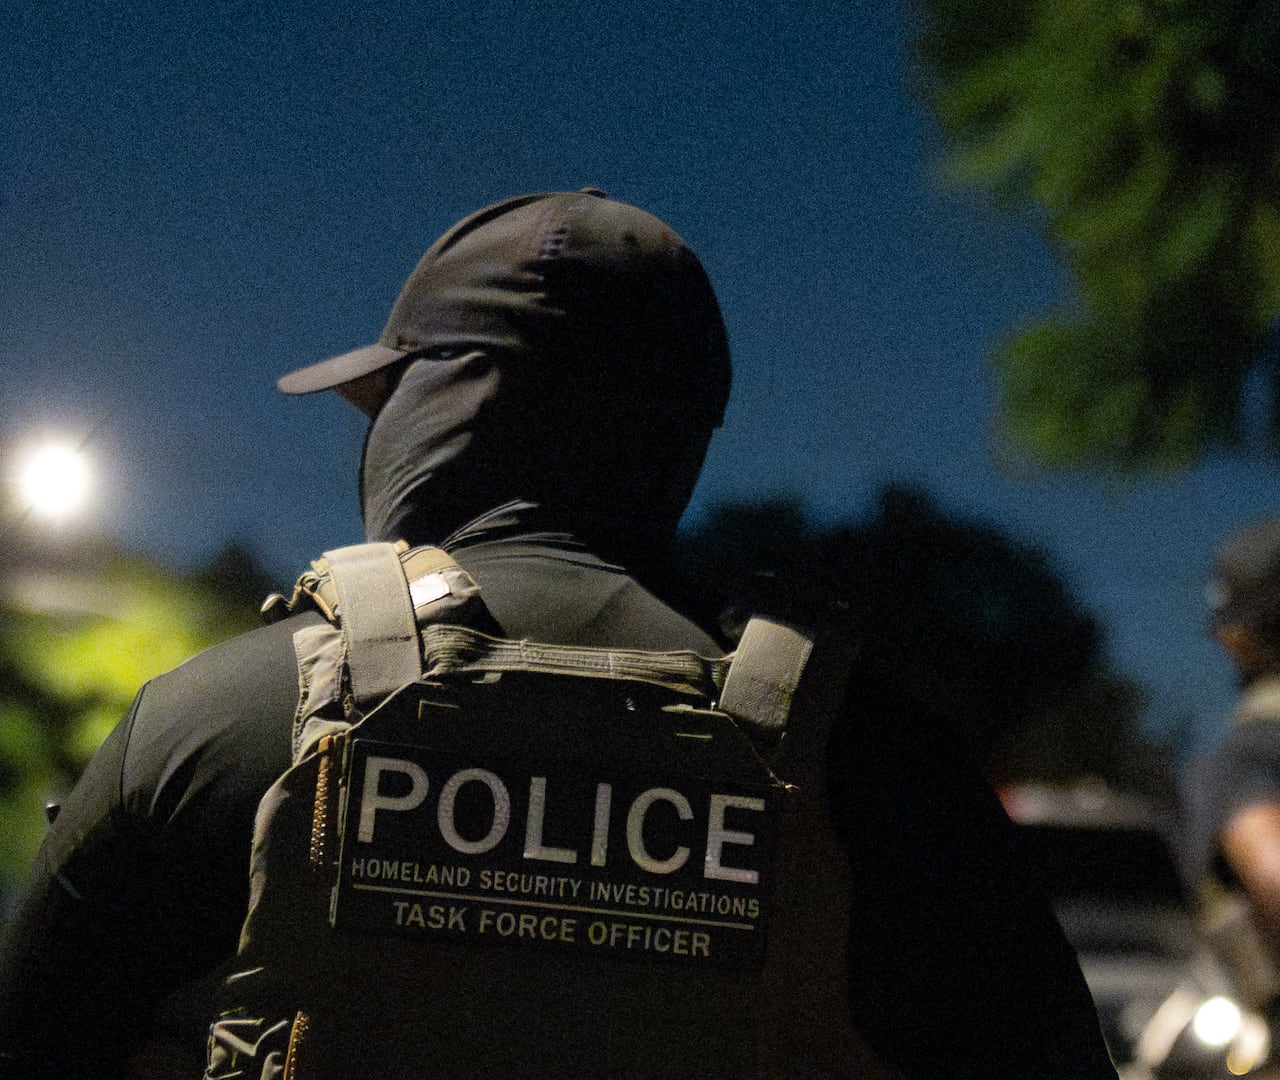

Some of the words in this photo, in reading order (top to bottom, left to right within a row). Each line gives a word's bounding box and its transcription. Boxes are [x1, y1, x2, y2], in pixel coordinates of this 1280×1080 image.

[357, 756, 765, 884] POLICE
[351, 857, 471, 888] HOMELAND
[479, 869, 582, 898] SECURITY
[589, 881, 760, 918] INVESTIGATIONS
[392, 901, 466, 931] TASK
[479, 911, 576, 942] FORCE
[587, 922, 711, 957] OFFICER
